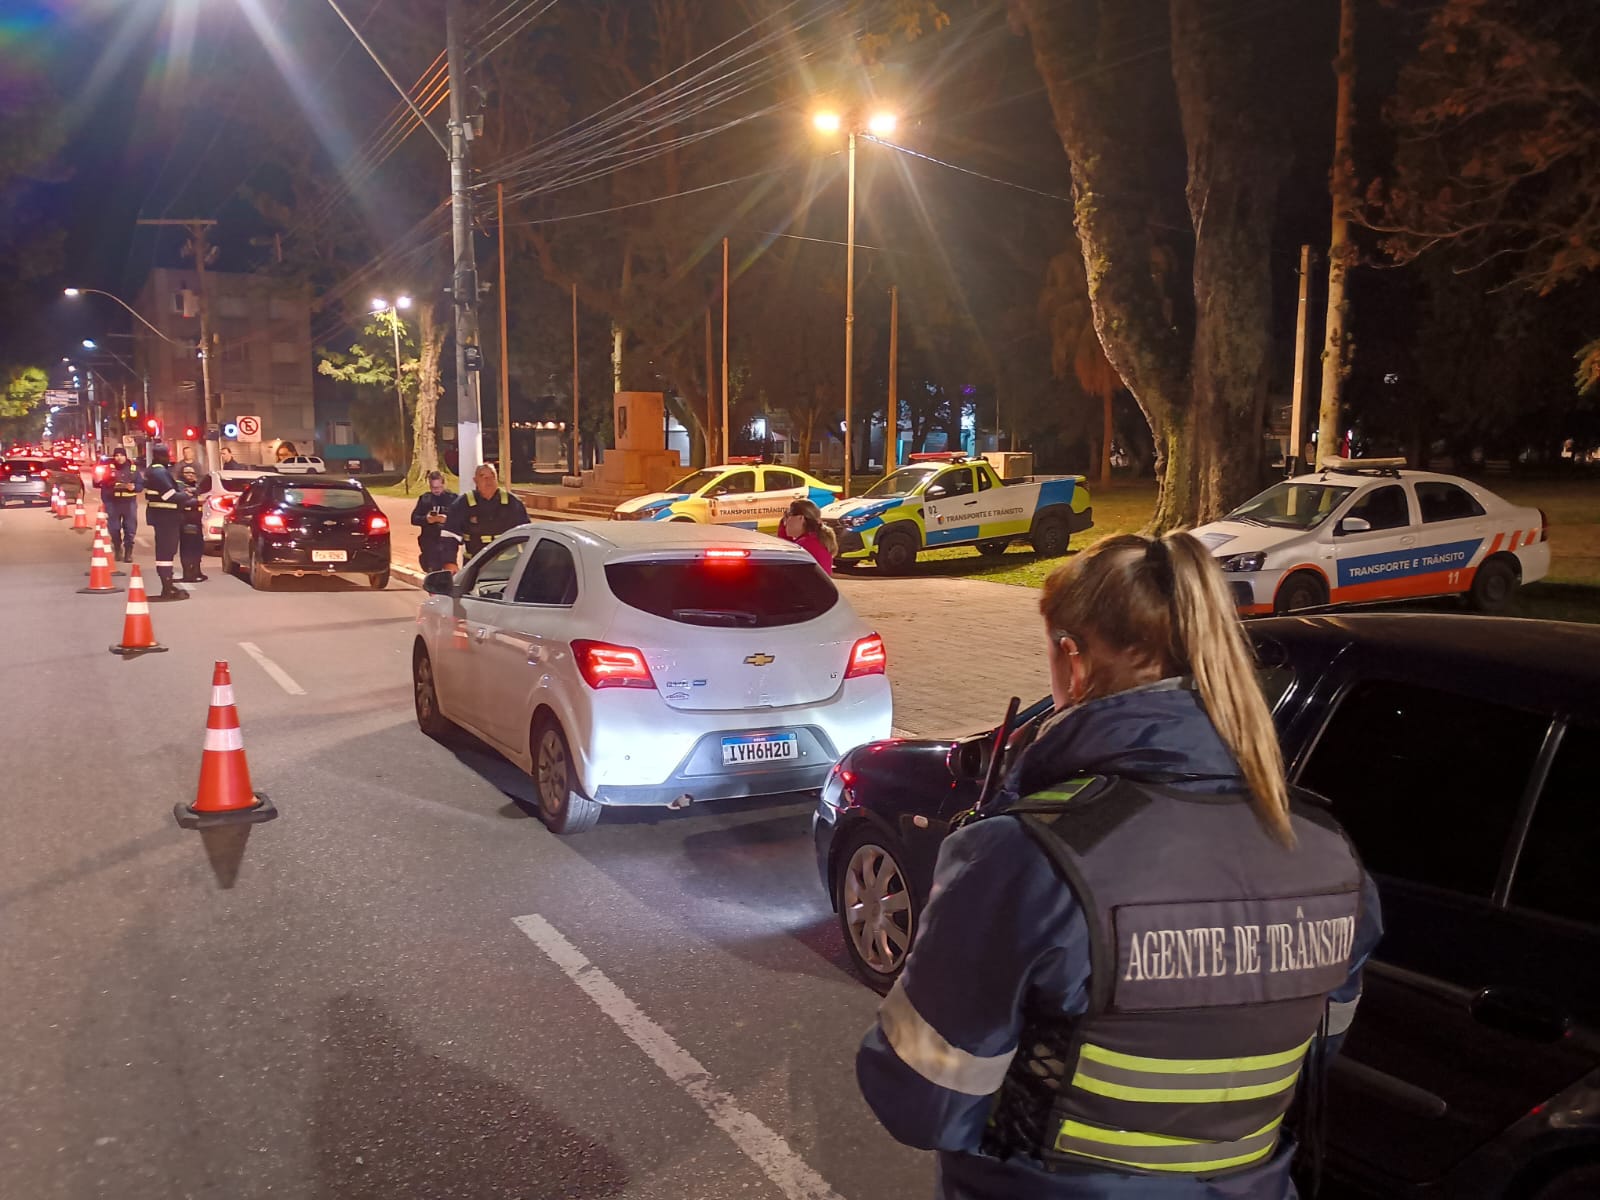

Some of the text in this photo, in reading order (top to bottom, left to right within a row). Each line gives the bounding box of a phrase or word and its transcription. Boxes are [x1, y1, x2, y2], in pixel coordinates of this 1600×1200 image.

[928, 505, 938, 514] 02
[946, 510, 987, 522] TRANSPORTE
[993, 507, 1024, 516] TRÂNSITO
[1349, 551, 1465, 577] TRANSPORTE E TRÂNSITO
[1448, 571, 1460, 584] 11
[730, 741, 791, 762] IYH6H20
[1124, 905, 1355, 981] AGENTE DE TRÂNSITO
